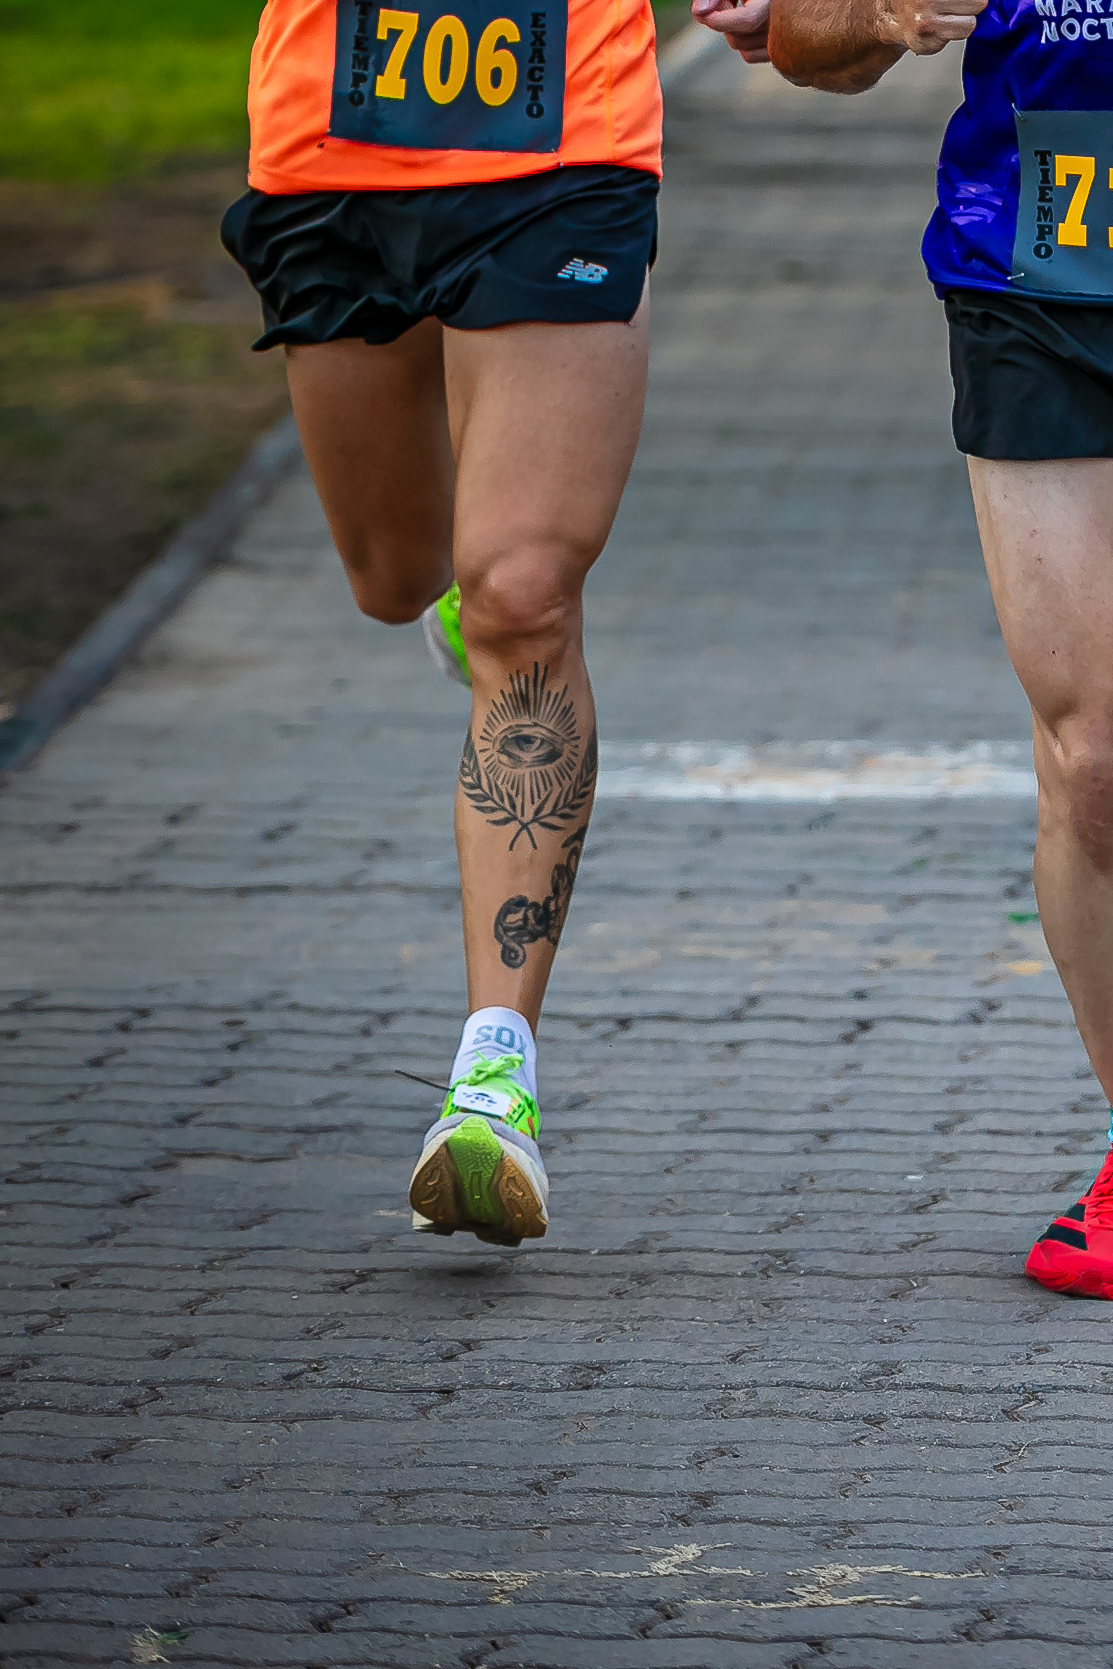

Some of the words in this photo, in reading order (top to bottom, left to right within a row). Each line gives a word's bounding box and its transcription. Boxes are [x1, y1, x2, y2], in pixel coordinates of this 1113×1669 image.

[347, 0, 373, 106] TIEMPO
[375, 8, 521, 107] 706
[525, 11, 547, 119] EXACTO
[1032, 149, 1054, 260] TIEMPO
